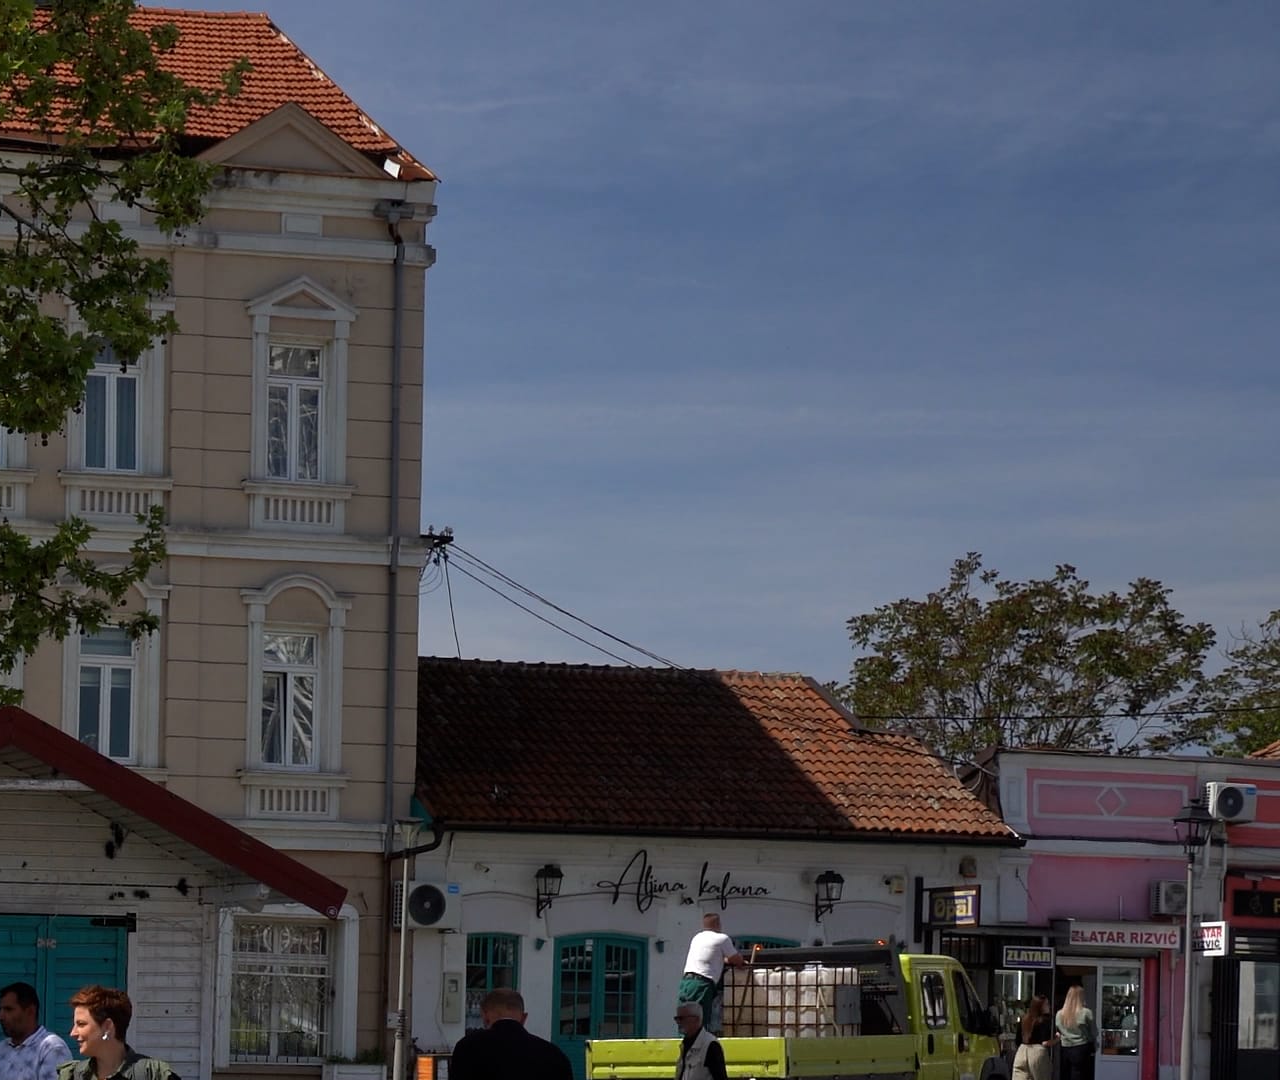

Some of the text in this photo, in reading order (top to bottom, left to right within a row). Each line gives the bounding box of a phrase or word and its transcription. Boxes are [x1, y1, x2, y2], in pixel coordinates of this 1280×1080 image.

[698, 861, 771, 911] kafana
[1071, 929, 1177, 945] ZLATAR RIZVIĆ
